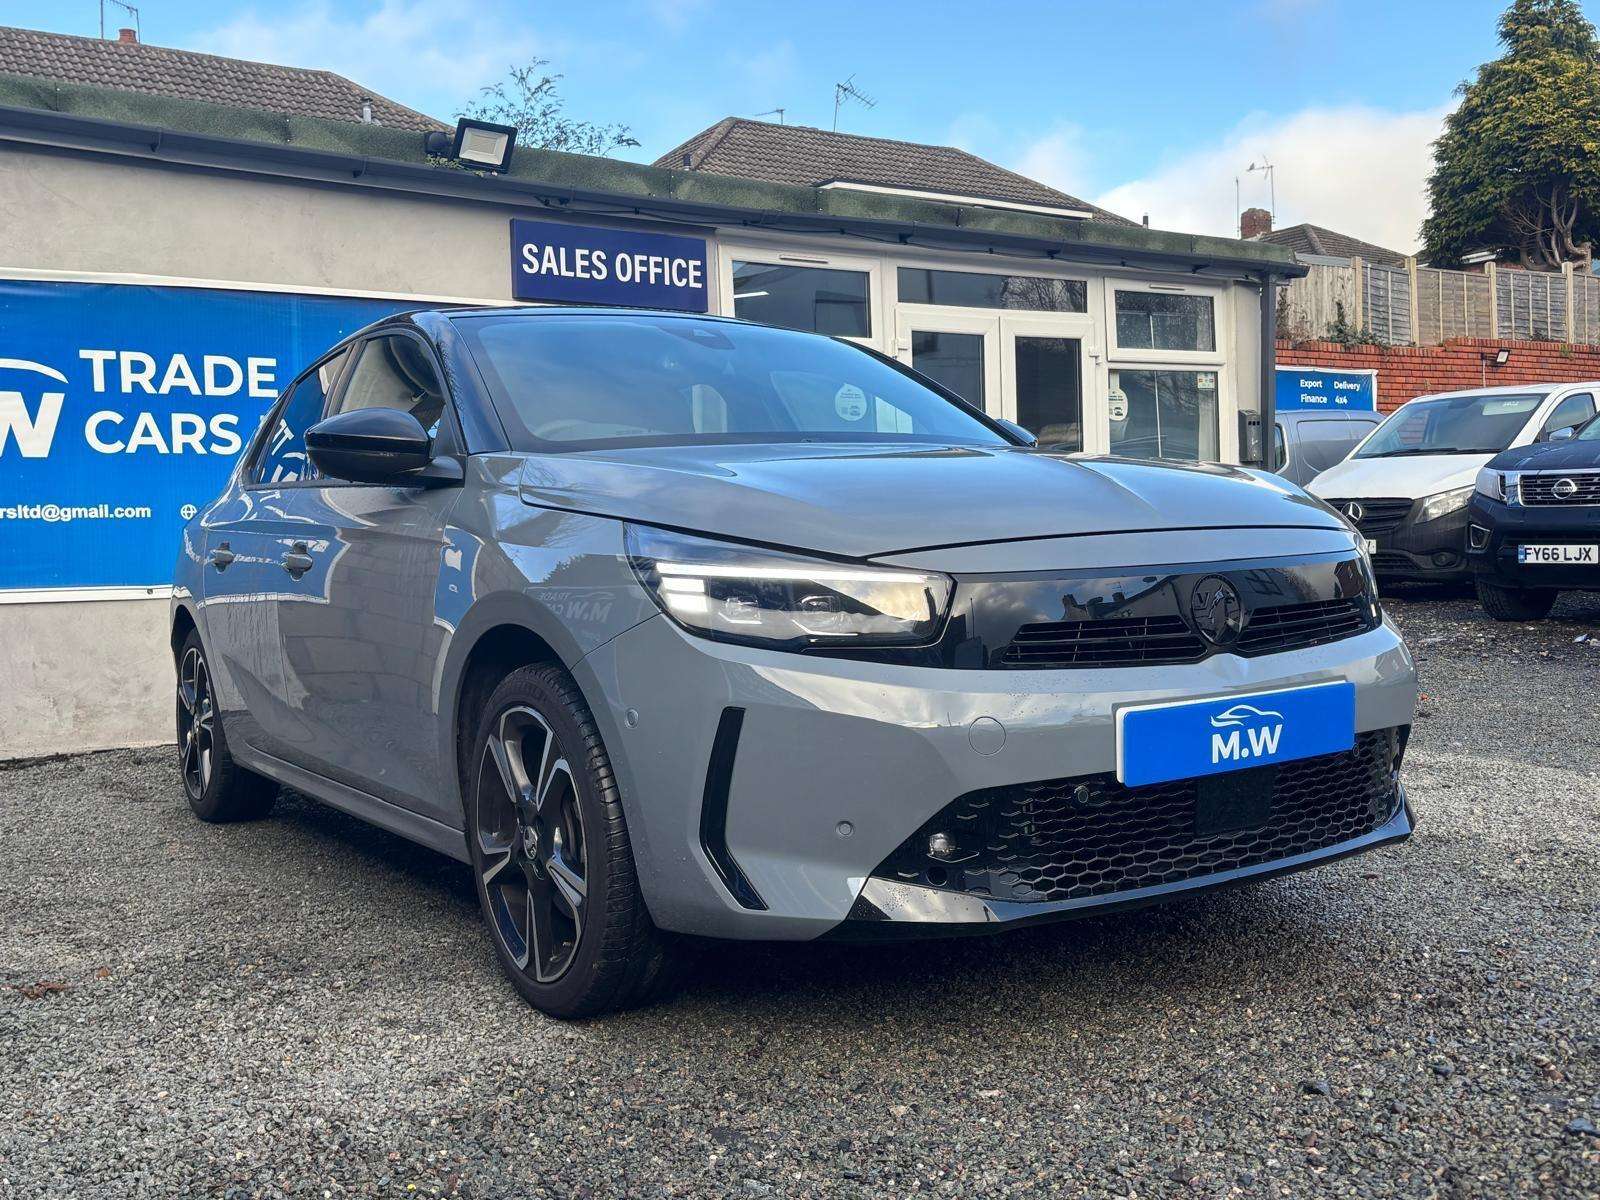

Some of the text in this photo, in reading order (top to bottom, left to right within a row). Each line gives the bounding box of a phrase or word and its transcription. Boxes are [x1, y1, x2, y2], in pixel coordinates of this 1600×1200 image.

[522, 243, 703, 289] SALES OFFICE
[79, 349, 280, 398] TRADE
[1300, 379, 1361, 392] Export Delivery
[1300, 393, 1348, 405] Finance 4x4
[84, 410, 243, 456] CARS
[0, 504, 151, 522] rsltd@gmail.com
[1525, 547, 1592, 562] FY66 LJX
[1211, 723, 1283, 764] M.W
